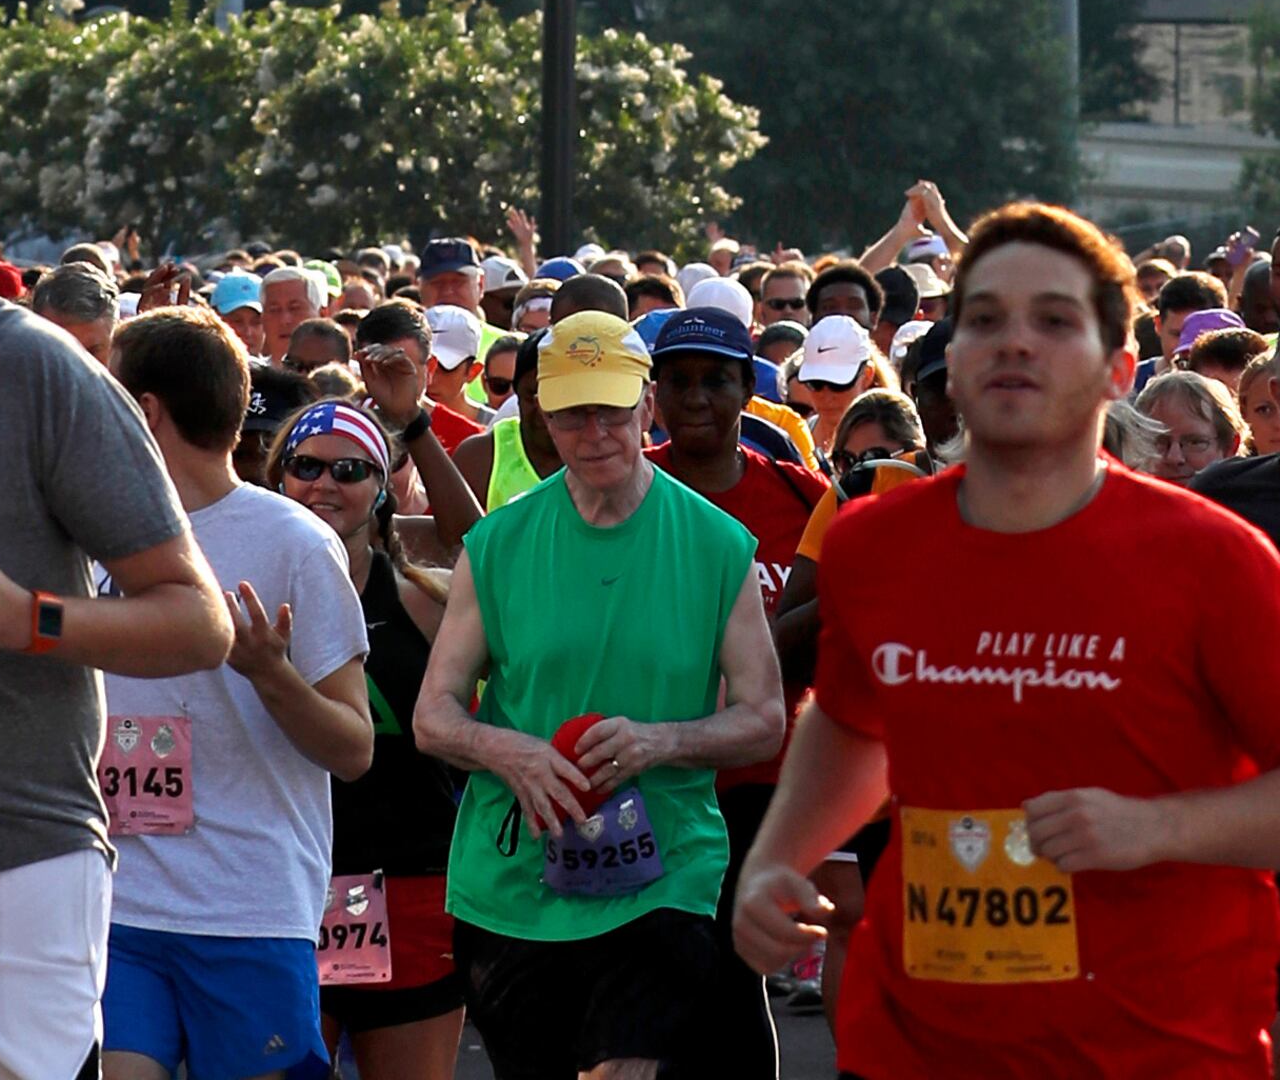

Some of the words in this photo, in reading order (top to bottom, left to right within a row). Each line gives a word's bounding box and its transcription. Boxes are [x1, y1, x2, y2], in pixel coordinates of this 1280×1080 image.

[976, 631, 1037, 657] PLAY
[1044, 633, 1101, 660] LIKE
[1109, 637, 1126, 661] A
[872, 642, 1122, 703] Champion
[96, 766, 183, 798] 3145
[562, 832, 655, 871] 59255
[907, 883, 928, 923] N
[937, 886, 1069, 926] 47802
